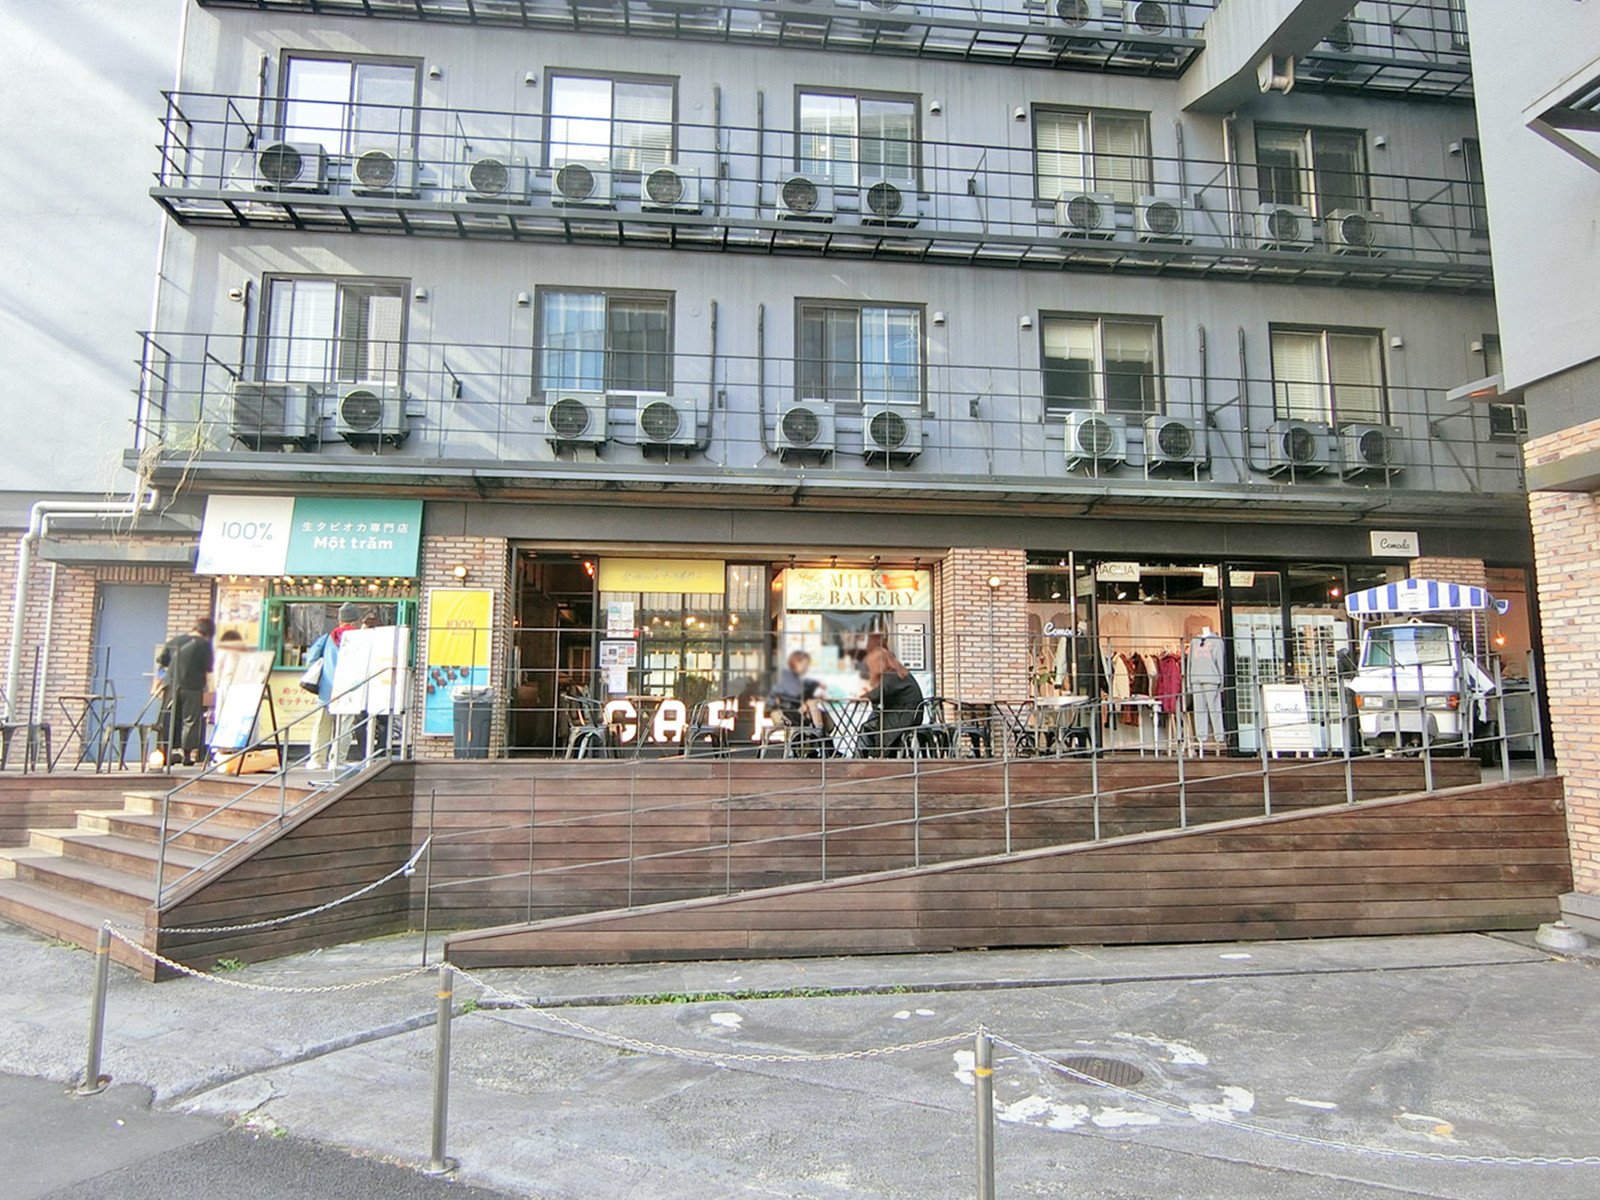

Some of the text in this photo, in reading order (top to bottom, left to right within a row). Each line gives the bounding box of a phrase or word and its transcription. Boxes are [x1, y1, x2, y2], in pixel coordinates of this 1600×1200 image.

[221, 521, 273, 541] 100%
[313, 535, 393, 551] Một trăm
[829, 573, 882, 589] MILK
[829, 590, 917, 606] BAKERY
[1043, 621, 1082, 637] Comoo
